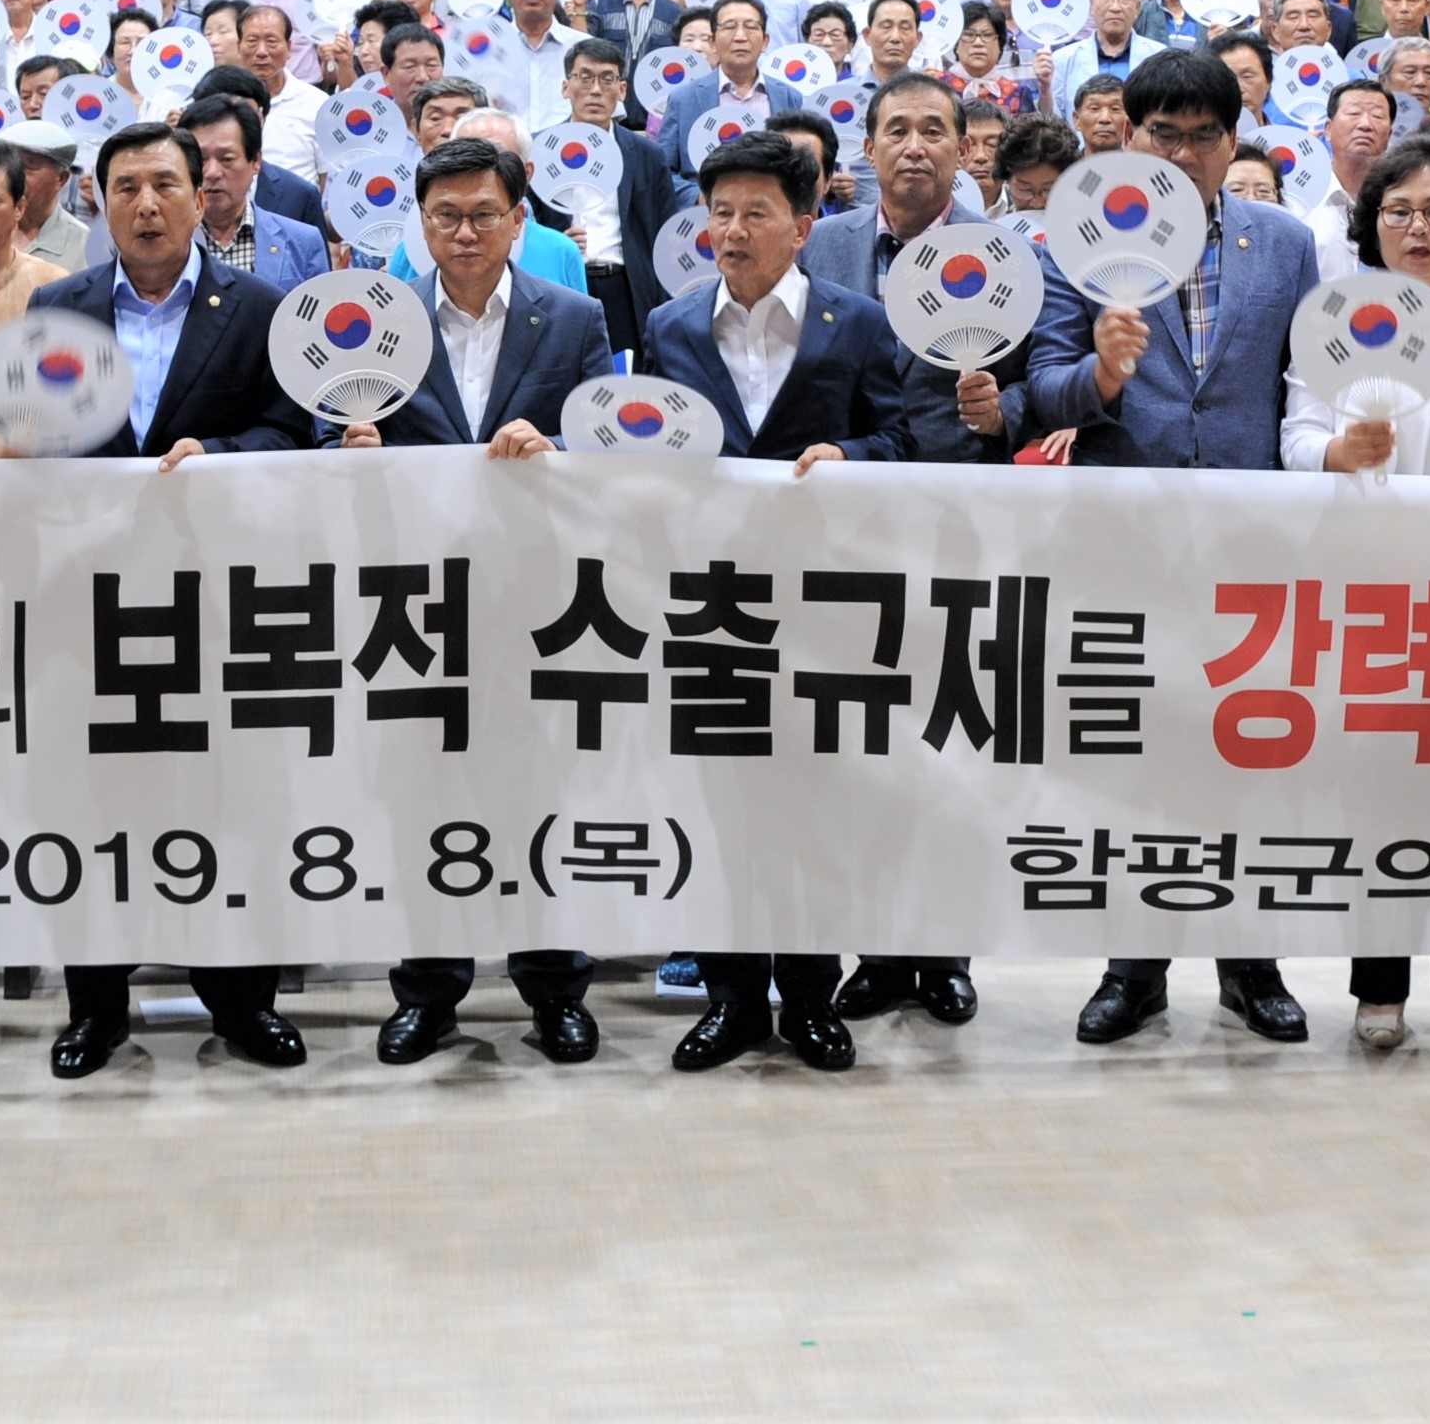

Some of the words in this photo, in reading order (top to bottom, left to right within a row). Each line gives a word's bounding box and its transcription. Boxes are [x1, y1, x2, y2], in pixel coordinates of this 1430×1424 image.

[87, 556, 472, 759] 보복적
[529, 557, 1156, 766] 수출규제를
[288, 825, 385, 903] 8.
[426, 813, 693, 901] 8.(목)
